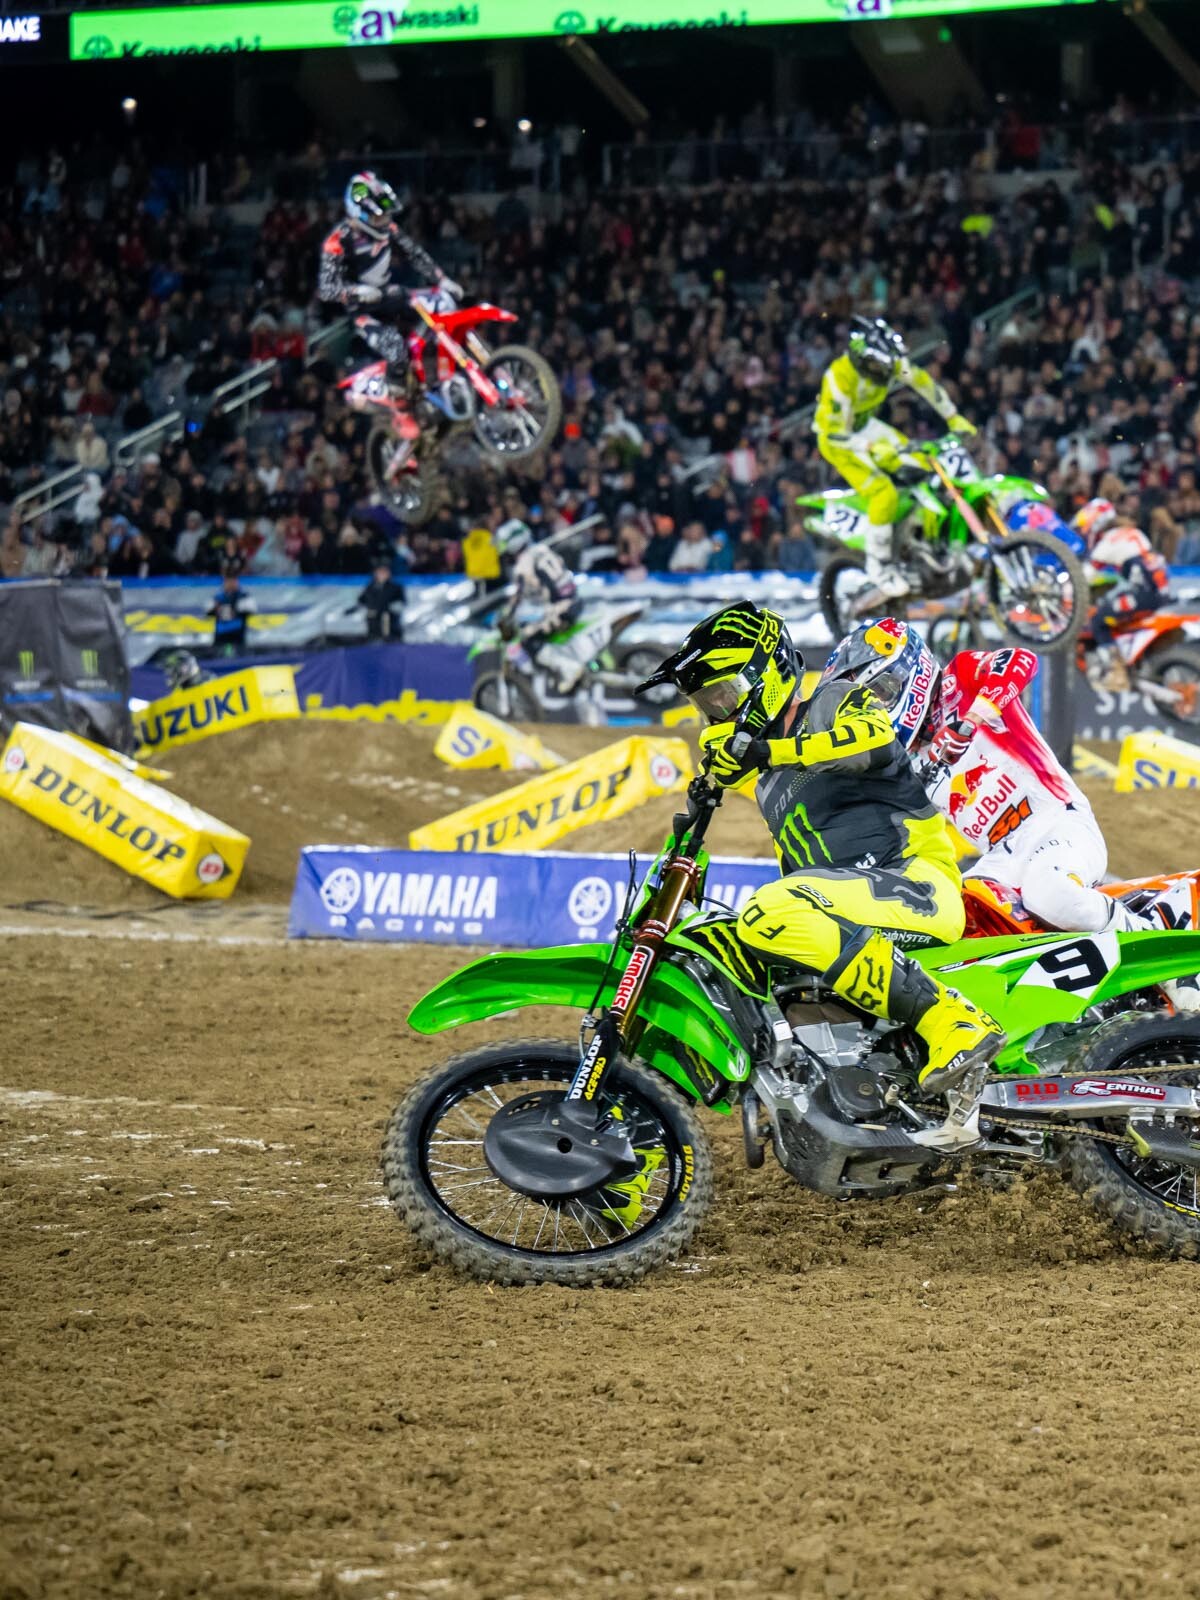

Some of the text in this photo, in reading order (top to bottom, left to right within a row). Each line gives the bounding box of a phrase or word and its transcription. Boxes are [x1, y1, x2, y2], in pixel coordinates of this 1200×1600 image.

[30, 764, 187, 863] DUNLOP
[455, 765, 633, 853] DUNLOP
[962, 806, 990, 842] Red
[980, 773, 1018, 817] Bull
[362, 871, 499, 919] YAMAHA
[329, 916, 484, 936] RACING
[612, 952, 647, 1010] SHOWA
[1037, 938, 1110, 993] 9
[570, 1034, 603, 1100] DUNLOP
[947, 1052, 966, 1070] FOX
[1072, 1080, 1165, 1097] RENTHAL
[679, 1144, 695, 1202] DUNLOP
